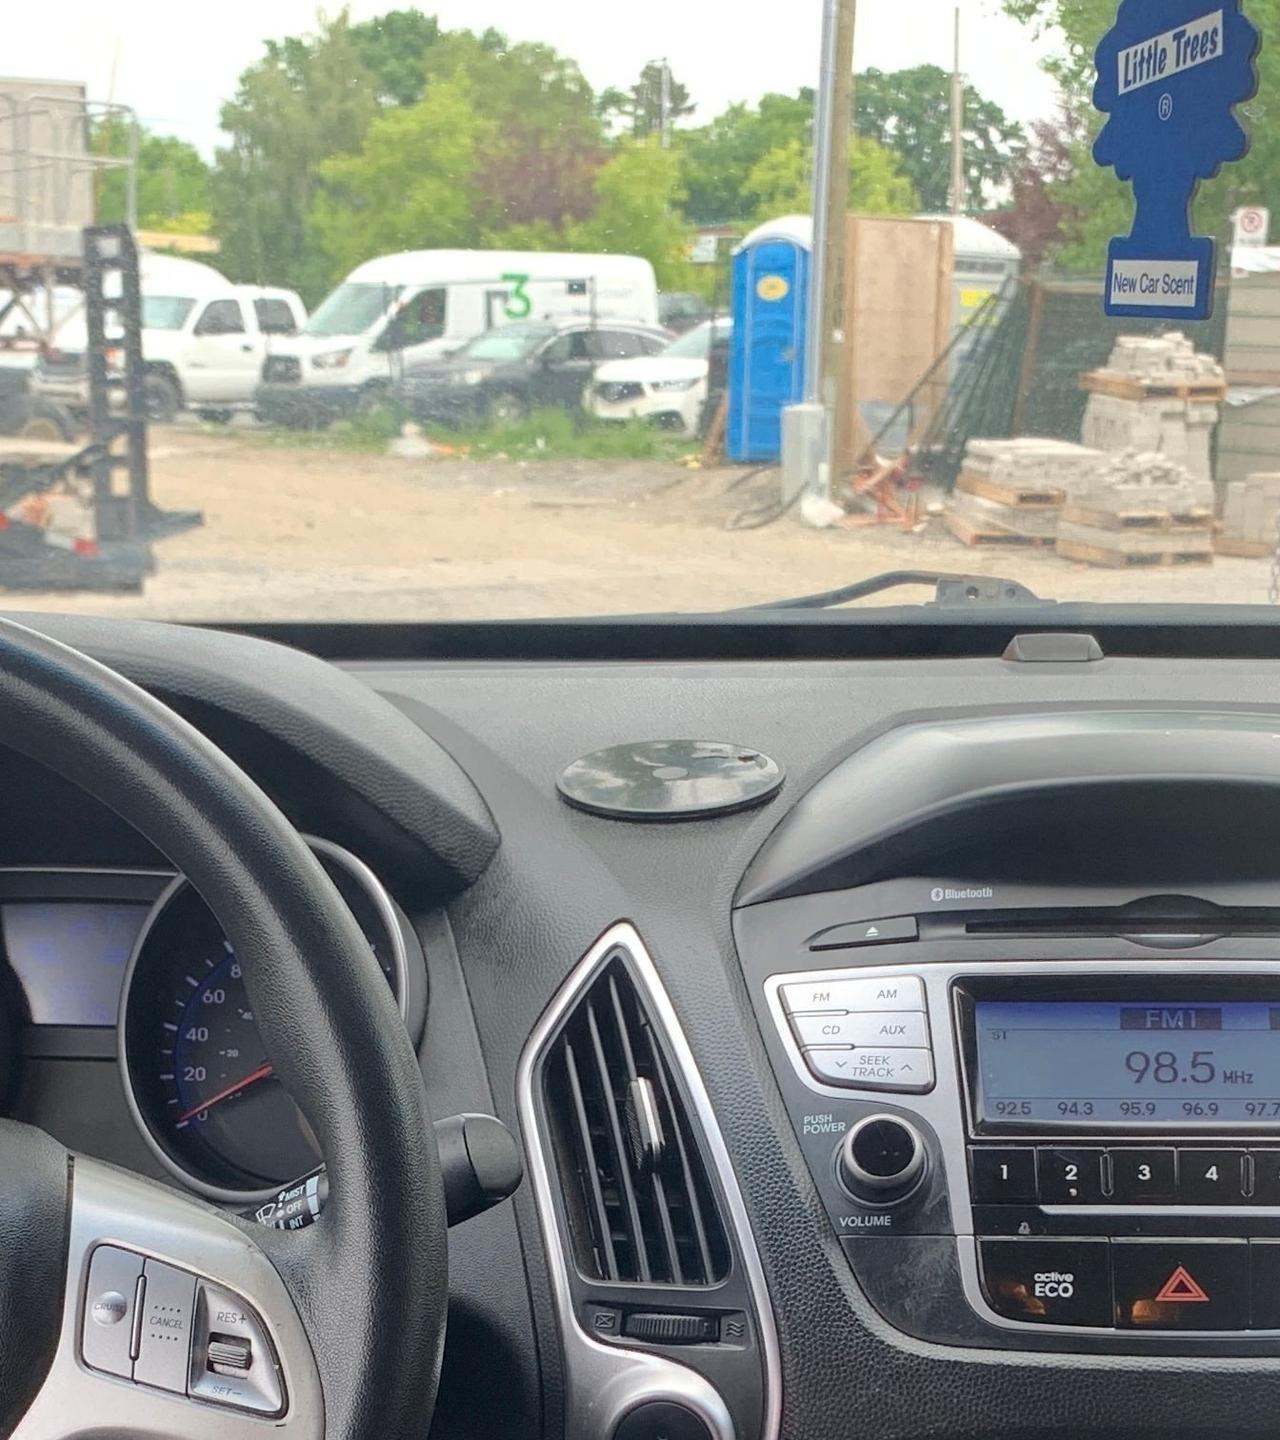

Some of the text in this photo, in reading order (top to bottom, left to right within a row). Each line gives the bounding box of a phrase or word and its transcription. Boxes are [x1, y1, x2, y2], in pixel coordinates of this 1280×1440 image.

[1123, 25, 1219, 88] Little Trees
[1113, 272, 1194, 295] New Car Scent
[501, 274, 531, 318] 3
[945, 888, 993, 899] Bluetooth
[202, 989, 225, 1004] 60
[813, 993, 830, 1002] FM
[877, 990, 898, 1000] AM
[1145, 1009, 1197, 1028] FM1
[186, 1027, 208, 1042] 40
[822, 1025, 840, 1035] CD
[880, 1025, 906, 1035] AUX
[859, 1056, 891, 1065] SEEK
[1126, 1051, 1254, 1084] 98.5 MHz
[183, 1066, 206, 1081] 20
[852, 1067, 894, 1077] TRACK
[996, 1102, 1031, 1115] 92.5
[1057, 1102, 1094, 1115] 94.3
[1120, 1102, 1156, 1115] 95.9
[1182, 1102, 1218, 1116] 96.9
[1245, 1102, 1280, 1116] 97.7
[804, 1114, 832, 1124] PUSH
[804, 1122, 846, 1135] POWER
[1000, 1165, 1009, 1180] 1
[1065, 1165, 1078, 1181] 2
[1138, 1166, 1151, 1181] 3
[1205, 1166, 1219, 1181] 4
[285, 1184, 306, 1201] MIST
[286, 1201, 302, 1214] OFF
[289, 1215, 303, 1230] INT
[840, 1215, 891, 1227] VOLUME
[1034, 1271, 1074, 1282] active
[1034, 1283, 1074, 1298] ECO
[150, 1316, 184, 1330] CANCEL
